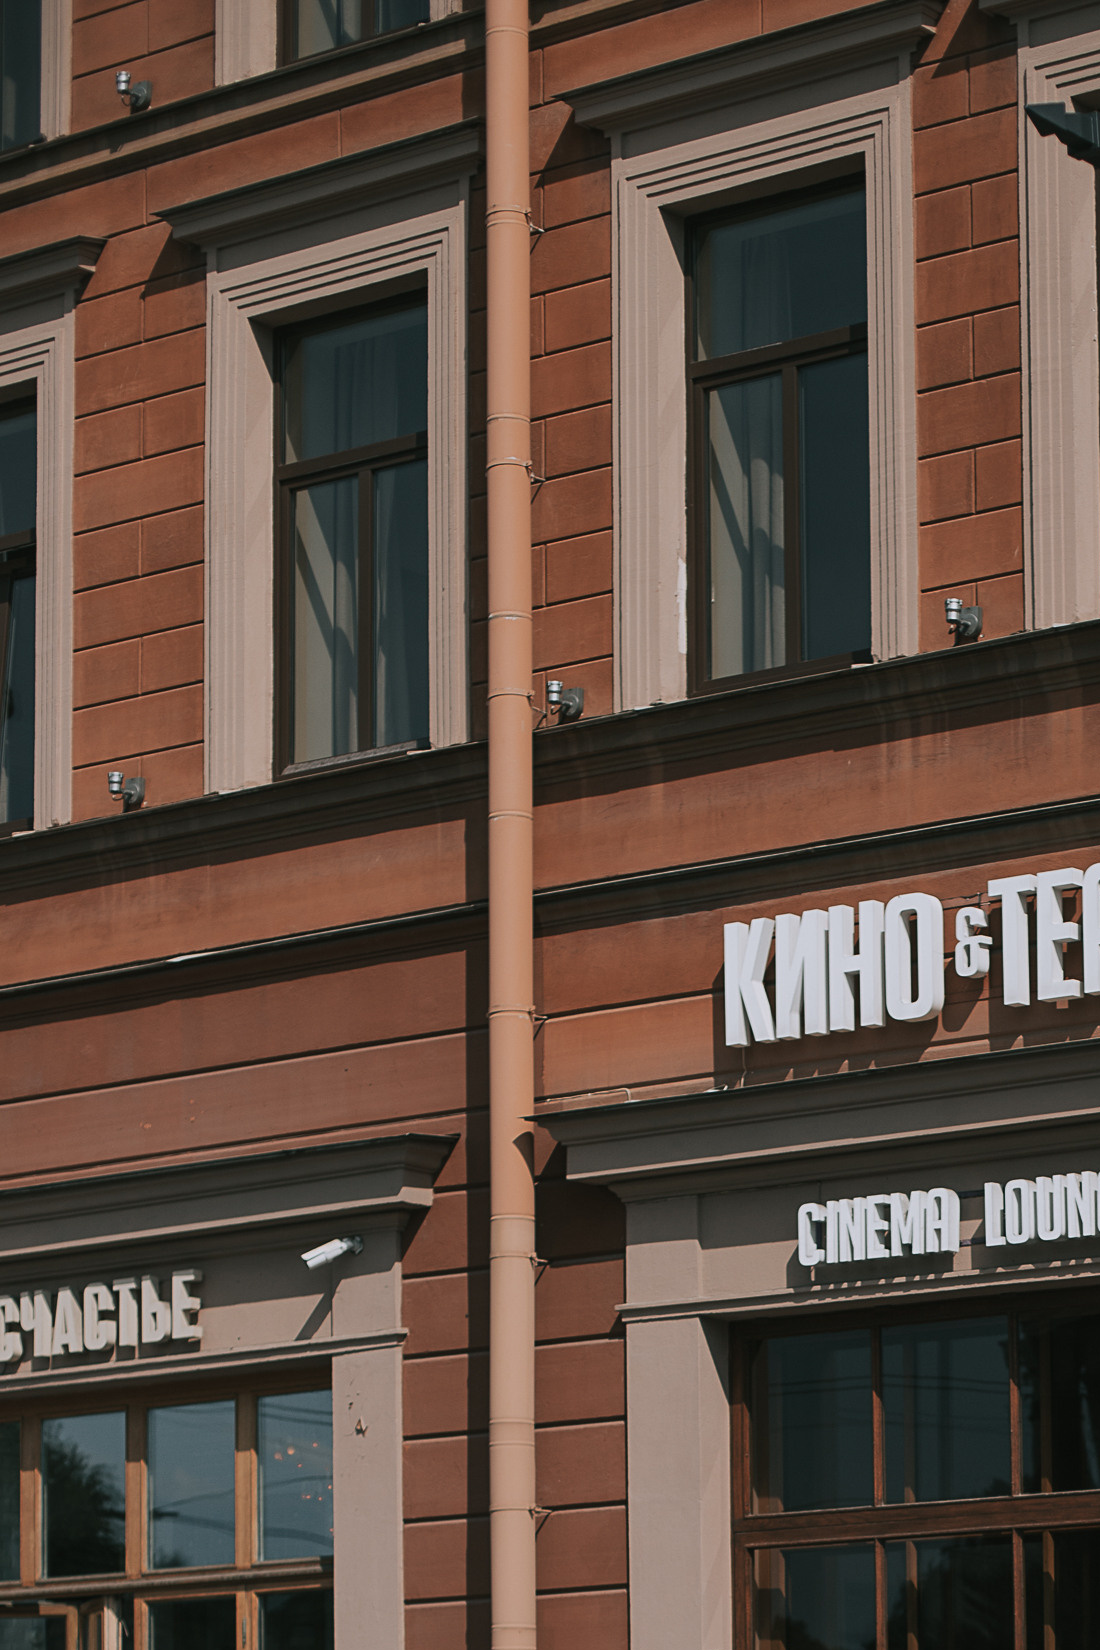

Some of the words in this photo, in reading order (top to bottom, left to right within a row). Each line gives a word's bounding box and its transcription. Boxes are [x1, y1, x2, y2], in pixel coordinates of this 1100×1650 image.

[723, 892, 944, 1047] КИНО
[798, 1187, 960, 1266] CINEMA
[0, 1269, 202, 1363] СЧАСТЬЕ
